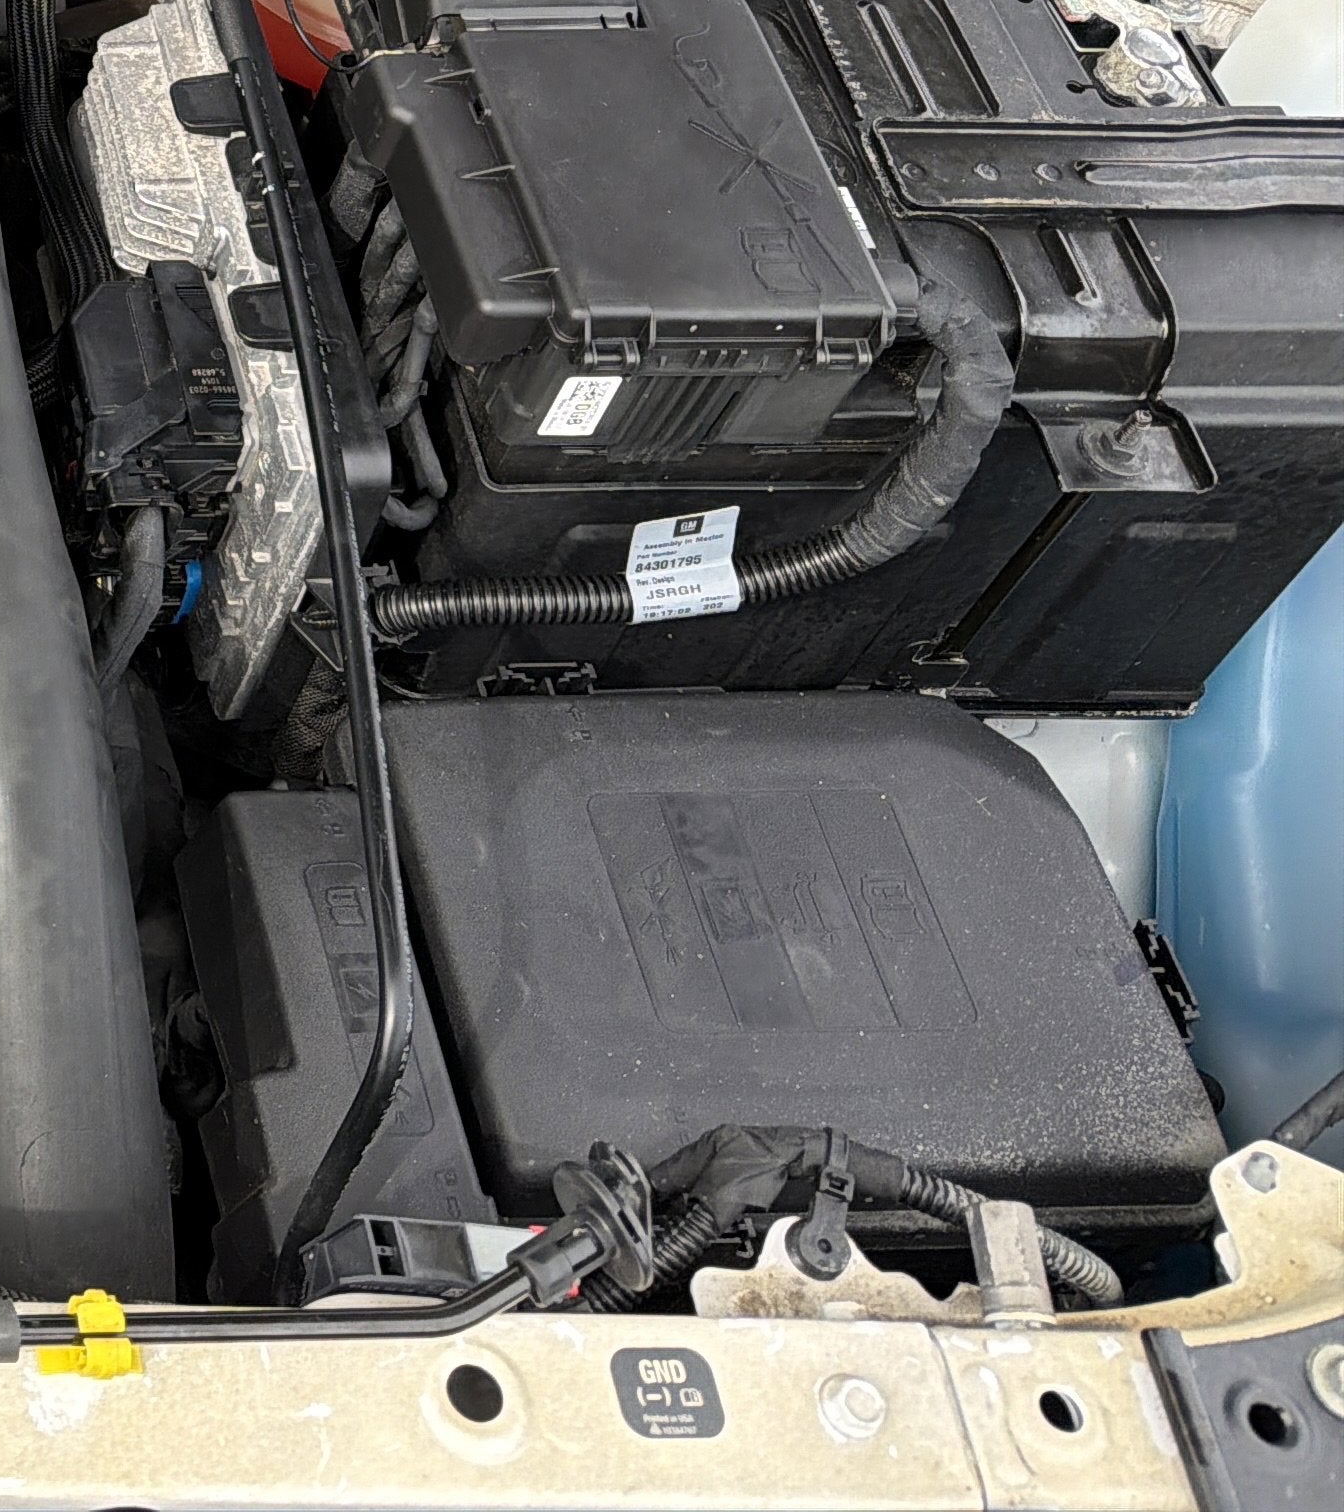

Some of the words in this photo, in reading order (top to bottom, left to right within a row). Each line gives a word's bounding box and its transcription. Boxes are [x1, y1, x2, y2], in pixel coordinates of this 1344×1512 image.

[680, 520, 698, 532] GM
[635, 555, 703, 573] 84301795
[646, 584, 702, 600] JSRGH
[638, 1358, 687, 1384] GND
